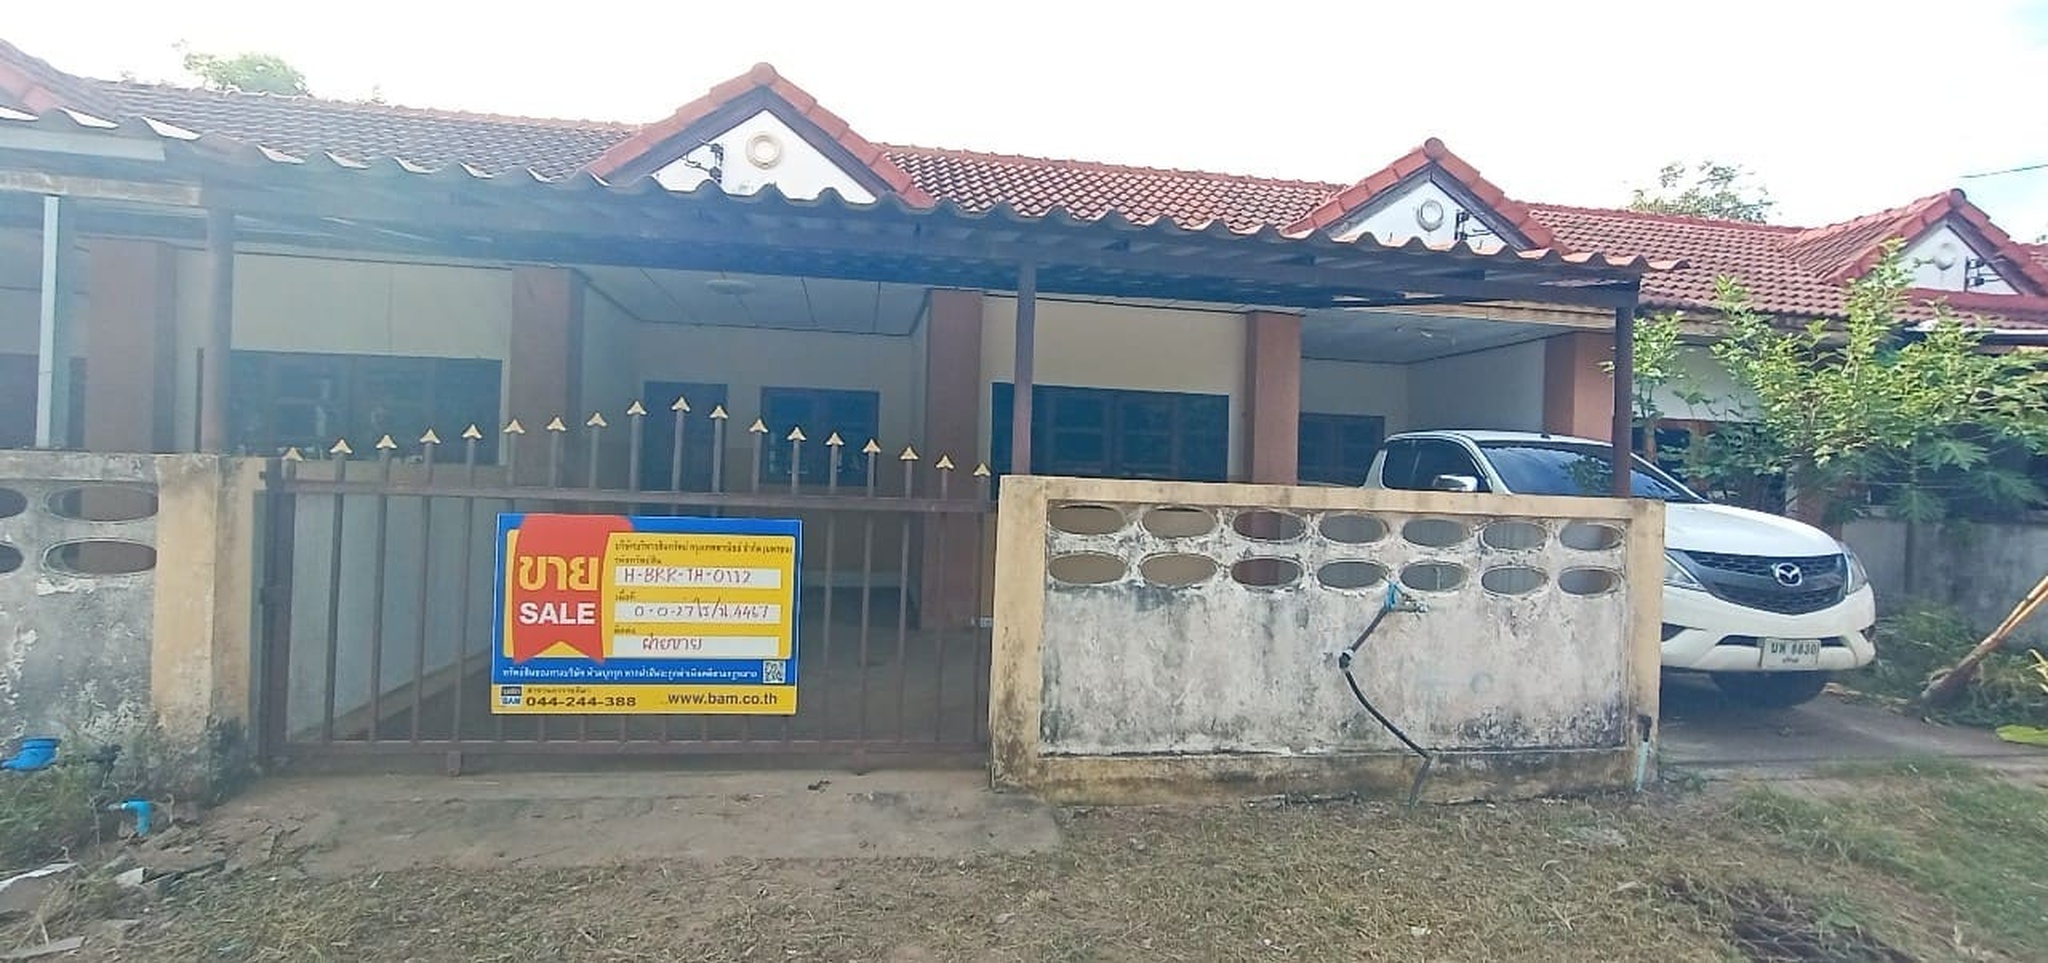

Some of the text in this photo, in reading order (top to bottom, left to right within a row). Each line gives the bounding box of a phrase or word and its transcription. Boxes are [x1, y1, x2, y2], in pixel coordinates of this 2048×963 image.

[518, 555, 599, 591] ขาย
[518, 601, 597, 626] SALE
[526, 696, 637, 707] 044-244-388
[668, 691, 778, 705] www.bam.co.th
